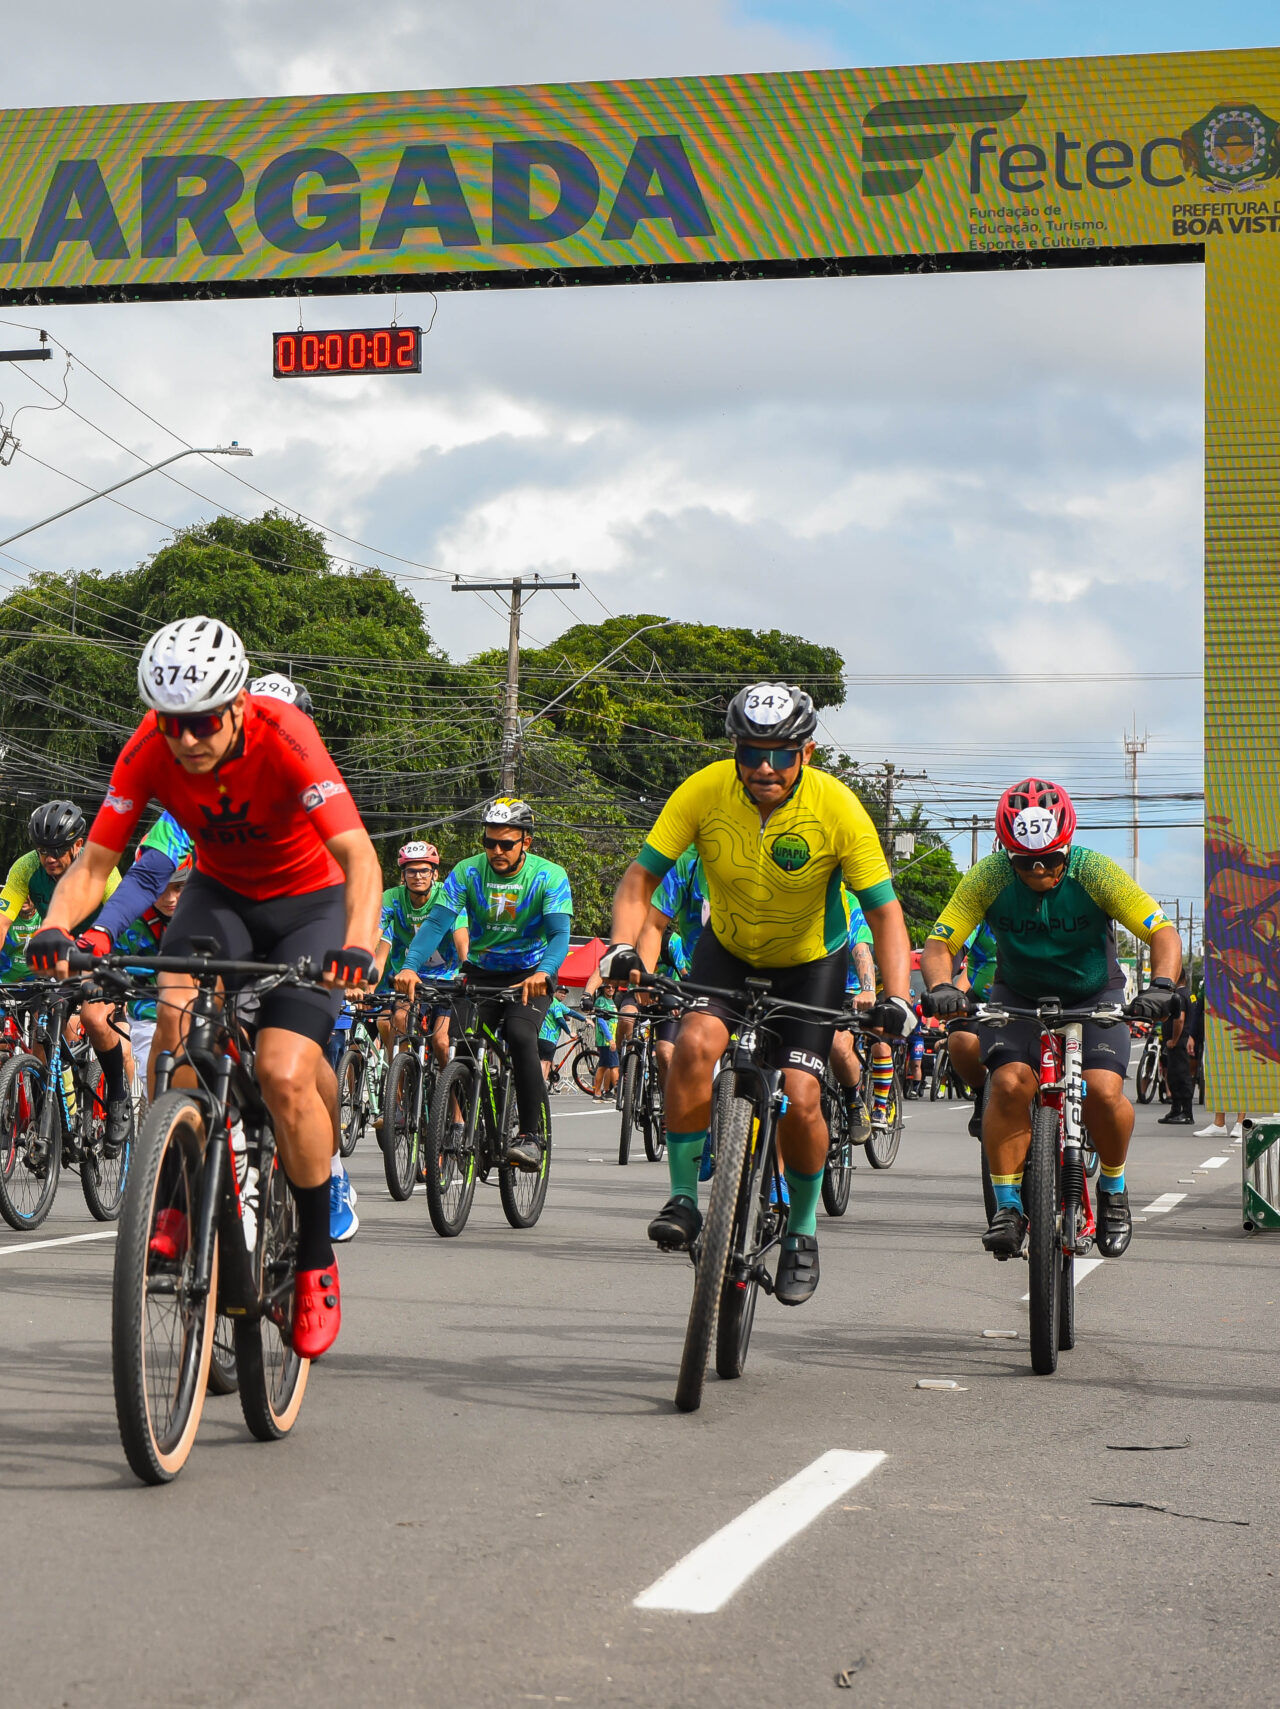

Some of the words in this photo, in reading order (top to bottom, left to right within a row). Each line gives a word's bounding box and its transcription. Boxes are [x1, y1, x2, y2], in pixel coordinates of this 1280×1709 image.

[969, 127, 1186, 194] fetec
[969, 205, 1040, 219] Fundação
[1043, 204, 1061, 216] de
[1172, 201, 1269, 218] PREFEITURA
[969, 222, 1042, 235] Educação,
[1046, 220, 1108, 232] Turismo,
[1172, 217, 1224, 236] BOA
[1228, 214, 1280, 234] VIST
[969, 238, 1025, 250] Esporte
[1029, 239, 1038, 249] e
[1041, 236, 1096, 248] Cultura
[277, 329, 416, 372] 00:00:02
[154, 665, 199, 687] 374
[255, 681, 293, 698] 294
[199, 825, 270, 845] EPIC
[1016, 817, 1053, 837] 357
[998, 915, 1089, 934] SUPAPUS
